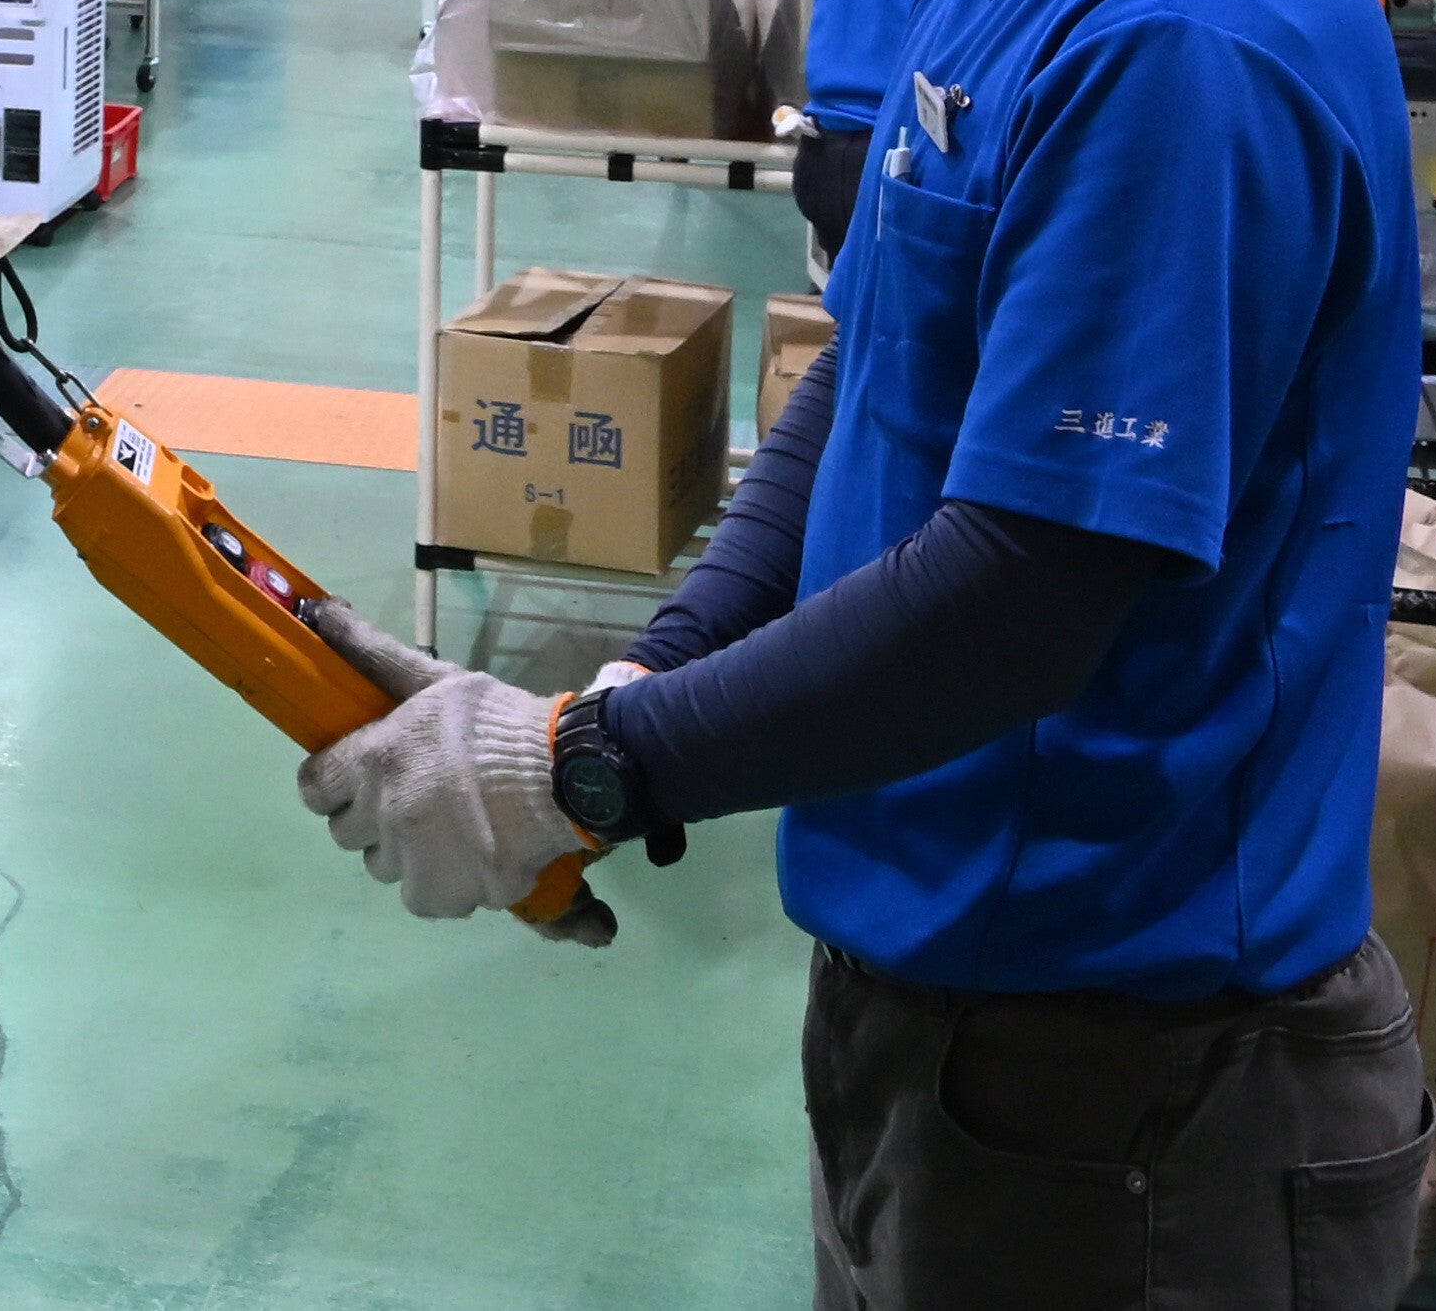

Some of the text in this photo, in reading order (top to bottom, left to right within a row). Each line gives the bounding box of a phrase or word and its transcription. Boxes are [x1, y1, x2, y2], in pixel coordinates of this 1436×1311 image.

[1053, 408, 1170, 450] 三進工業
[524, 483, 564, 505] S-1
